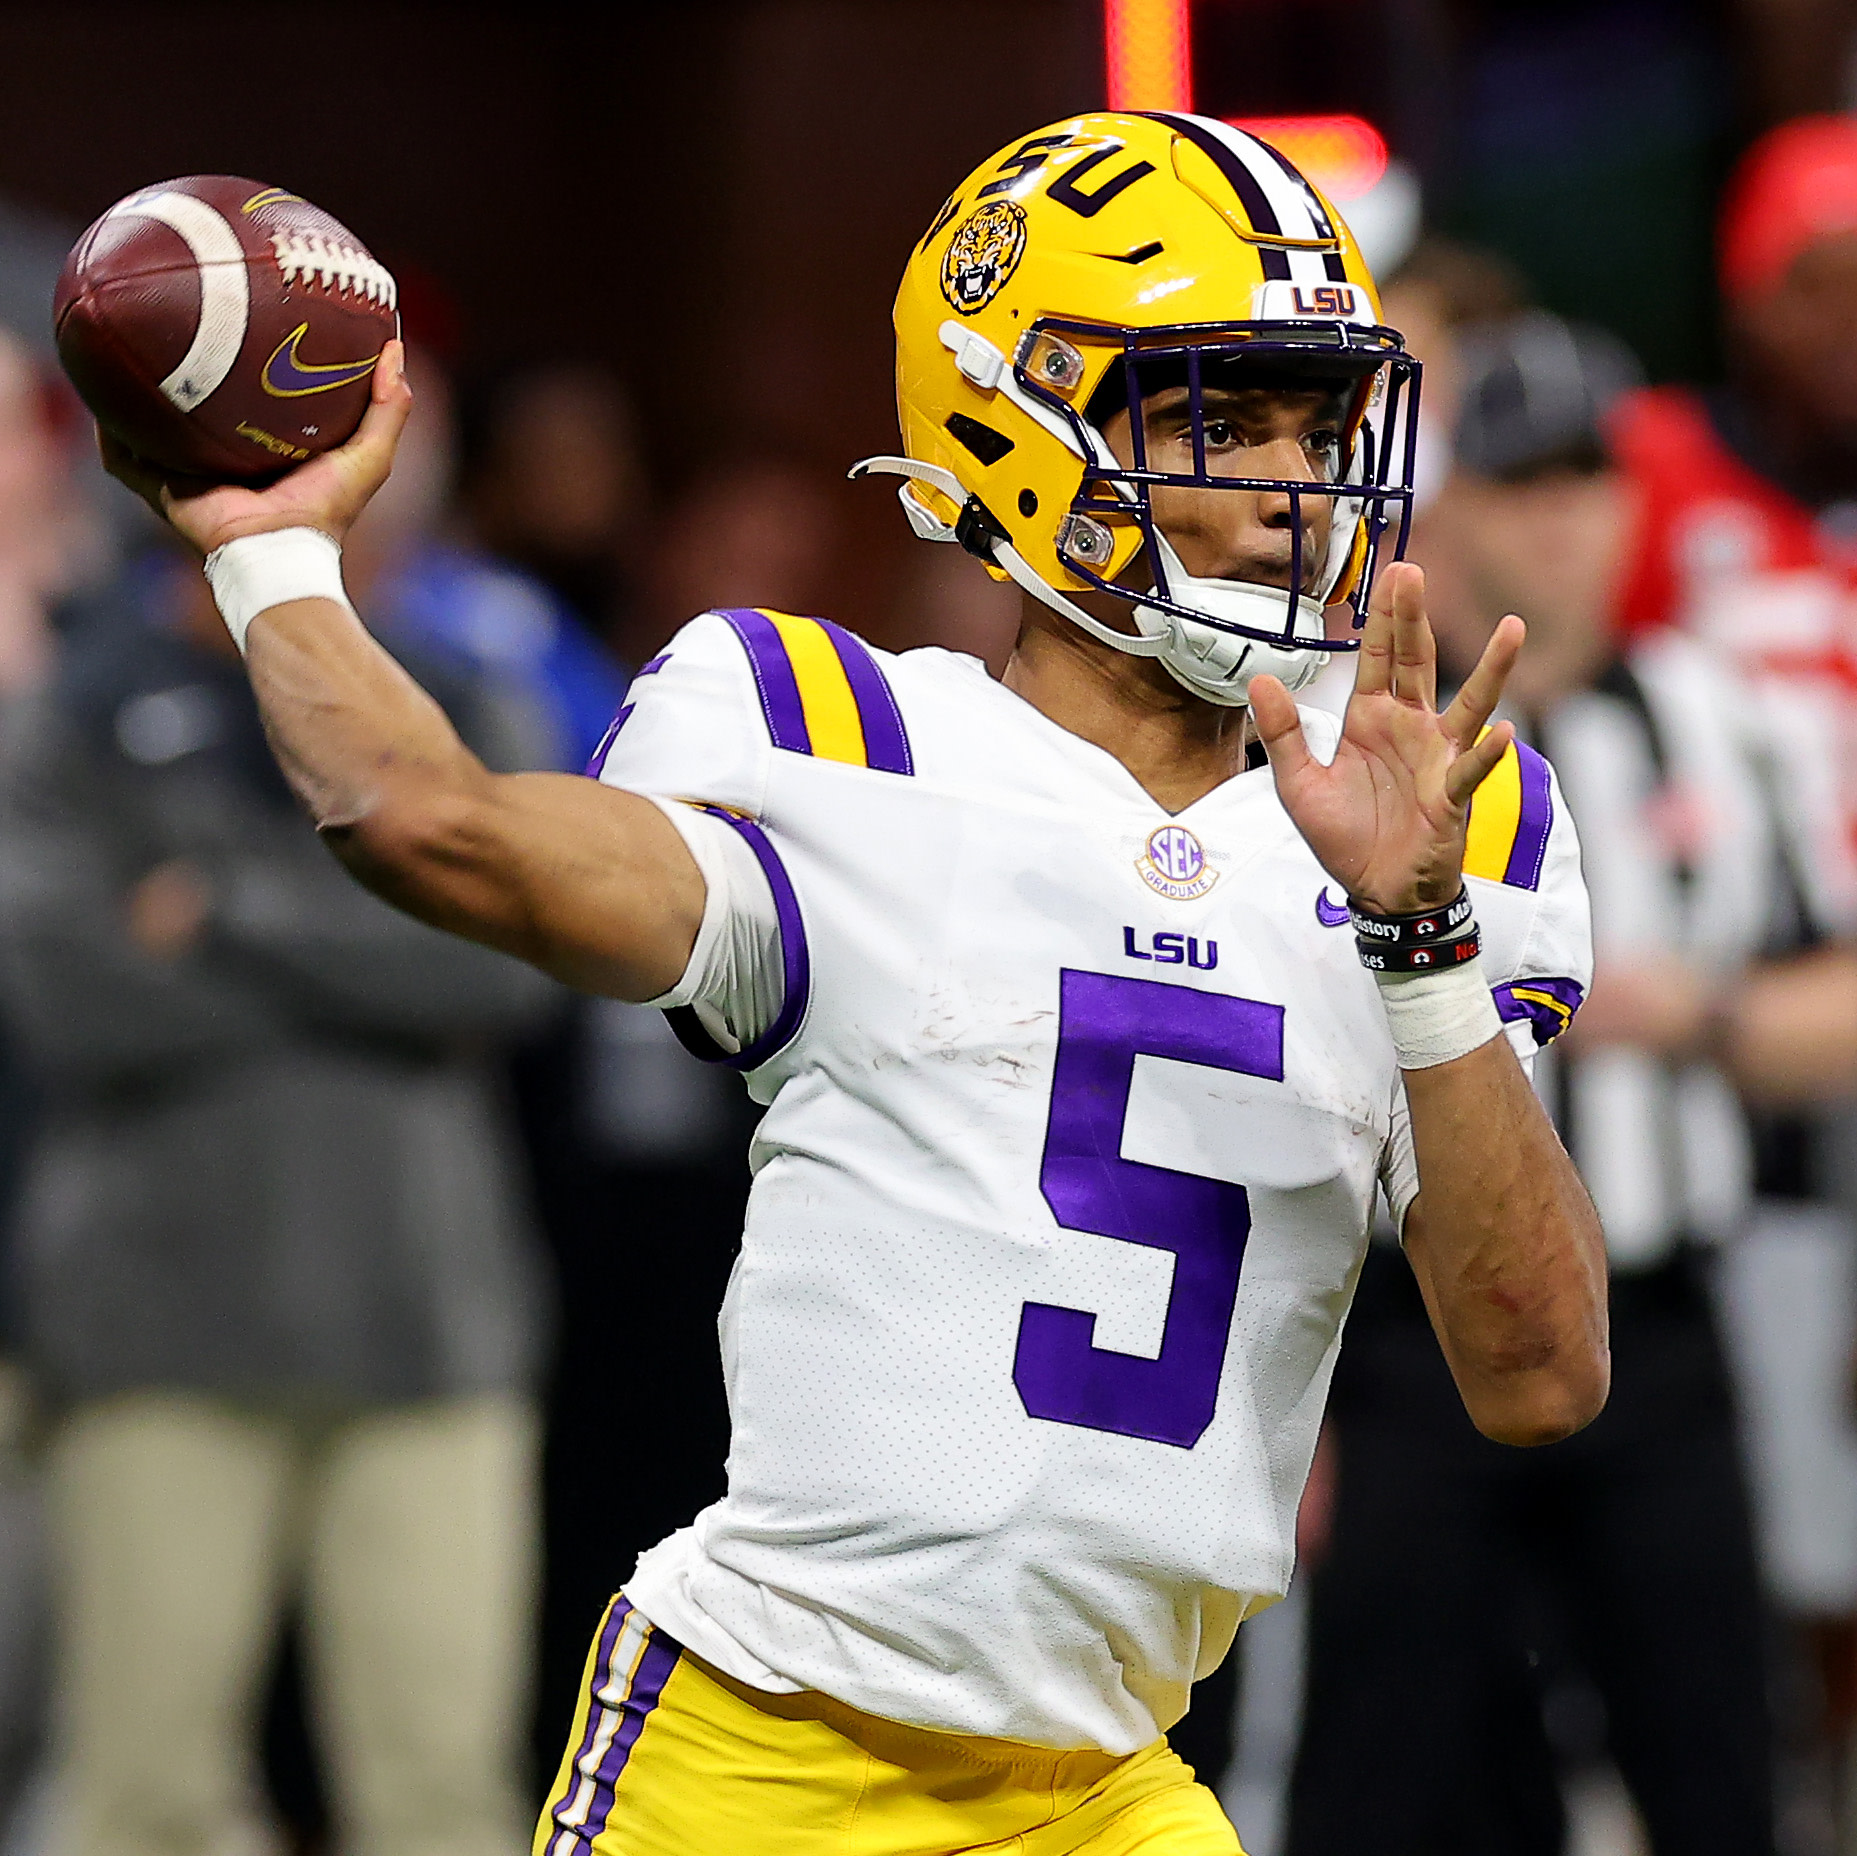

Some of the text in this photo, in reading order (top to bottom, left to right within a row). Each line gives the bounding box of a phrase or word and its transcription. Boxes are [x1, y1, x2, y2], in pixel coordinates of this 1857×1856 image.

[1291, 287, 1356, 316] LSU
[1151, 828, 1201, 880] SEC
[1146, 870, 1209, 897] GRADUATE
[1122, 926, 1218, 971] LSU
[1012, 966, 1286, 1451] 5
